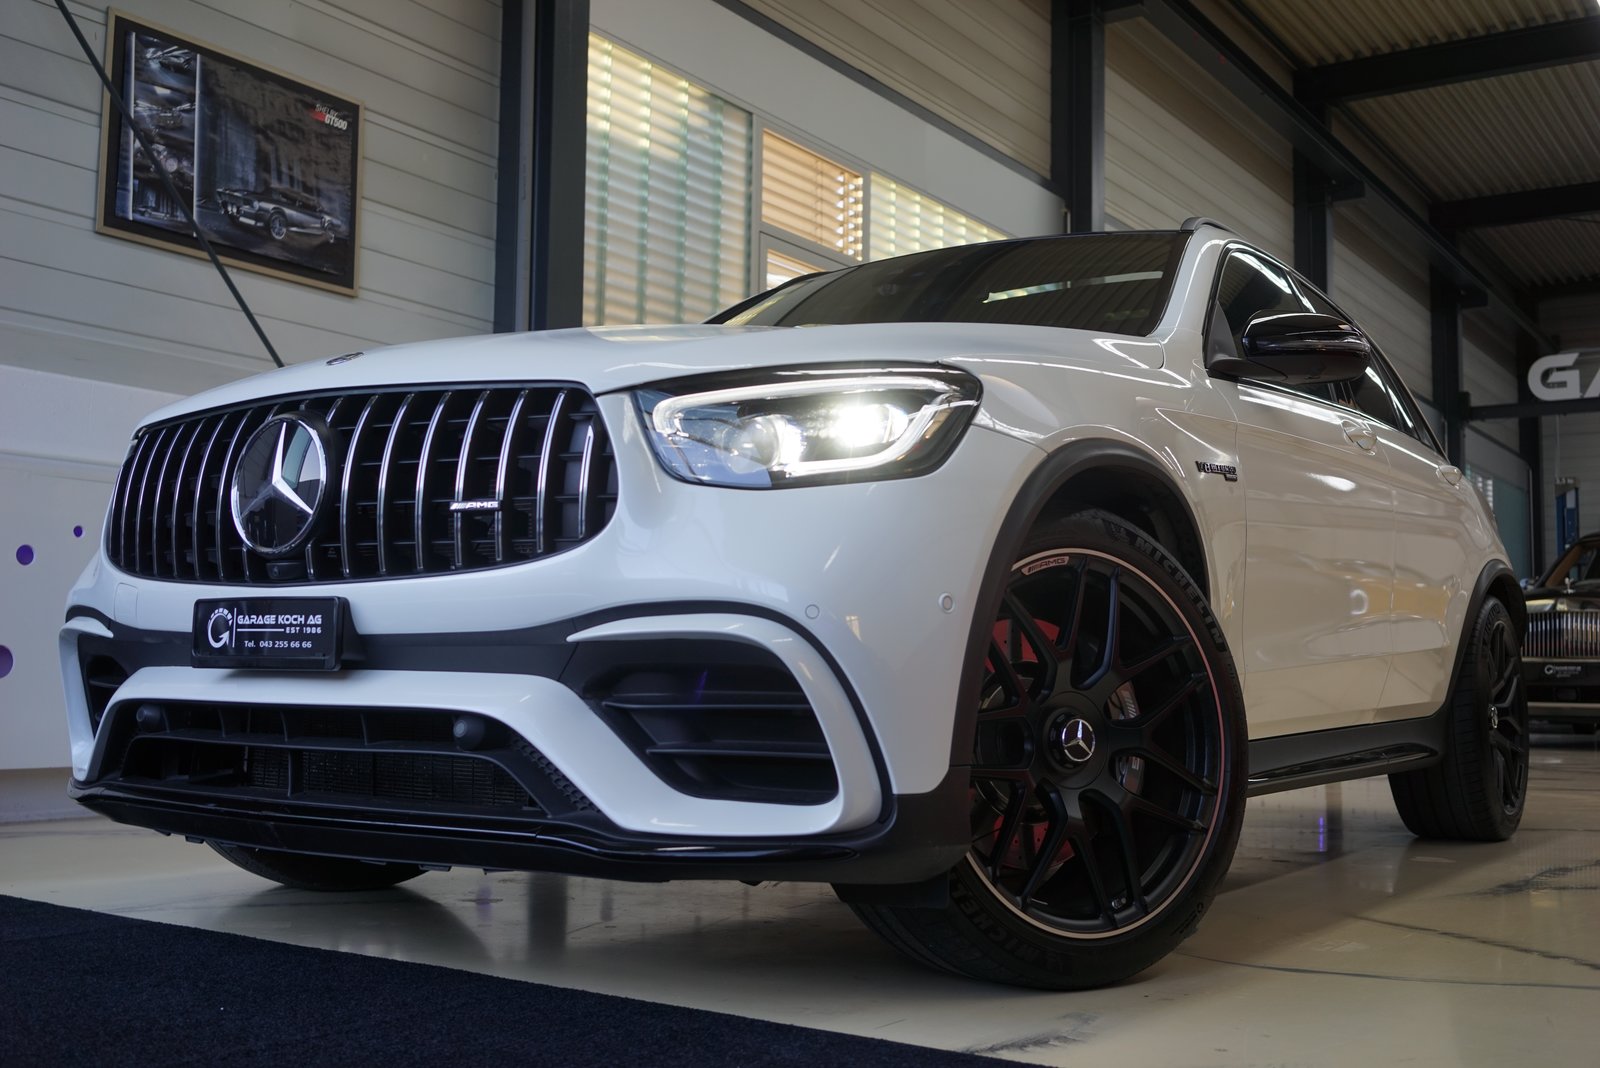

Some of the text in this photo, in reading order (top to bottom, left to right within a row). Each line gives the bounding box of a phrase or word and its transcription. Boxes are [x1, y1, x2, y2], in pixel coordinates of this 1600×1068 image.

[324, 113, 348, 130] GT500
[465, 501, 499, 509] AMG
[1040, 557, 1066, 568] AMG
[1135, 535, 1225, 646] MICHELIN
[237, 614, 276, 625] GARAGE
[278, 614, 305, 625] KOCH
[306, 614, 323, 625] AG
[285, 626, 322, 634] EST 1986
[244, 640, 312, 648] Tel. 043 255 66 66
